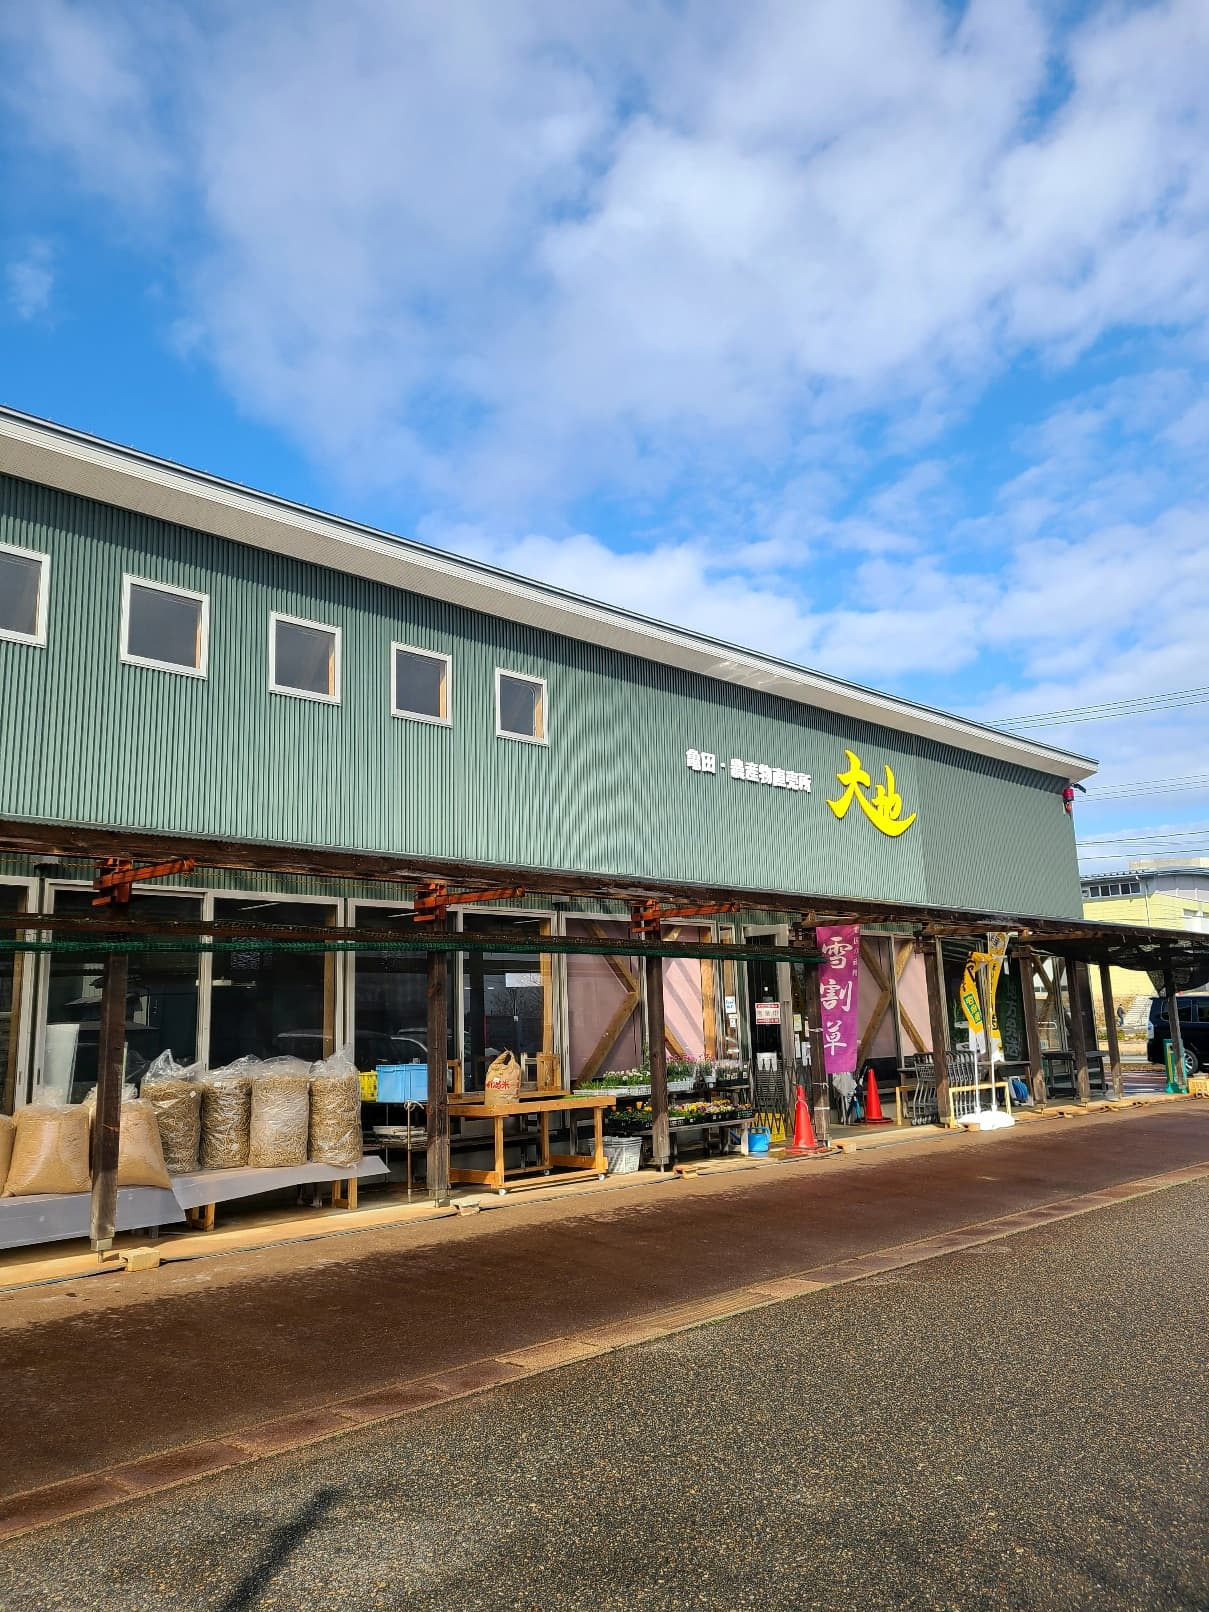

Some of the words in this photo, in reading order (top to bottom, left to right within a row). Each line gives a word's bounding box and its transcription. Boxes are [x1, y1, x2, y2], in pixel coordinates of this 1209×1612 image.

[826, 749, 917, 837] 大地
[820, 936, 853, 1056] 雪割草
